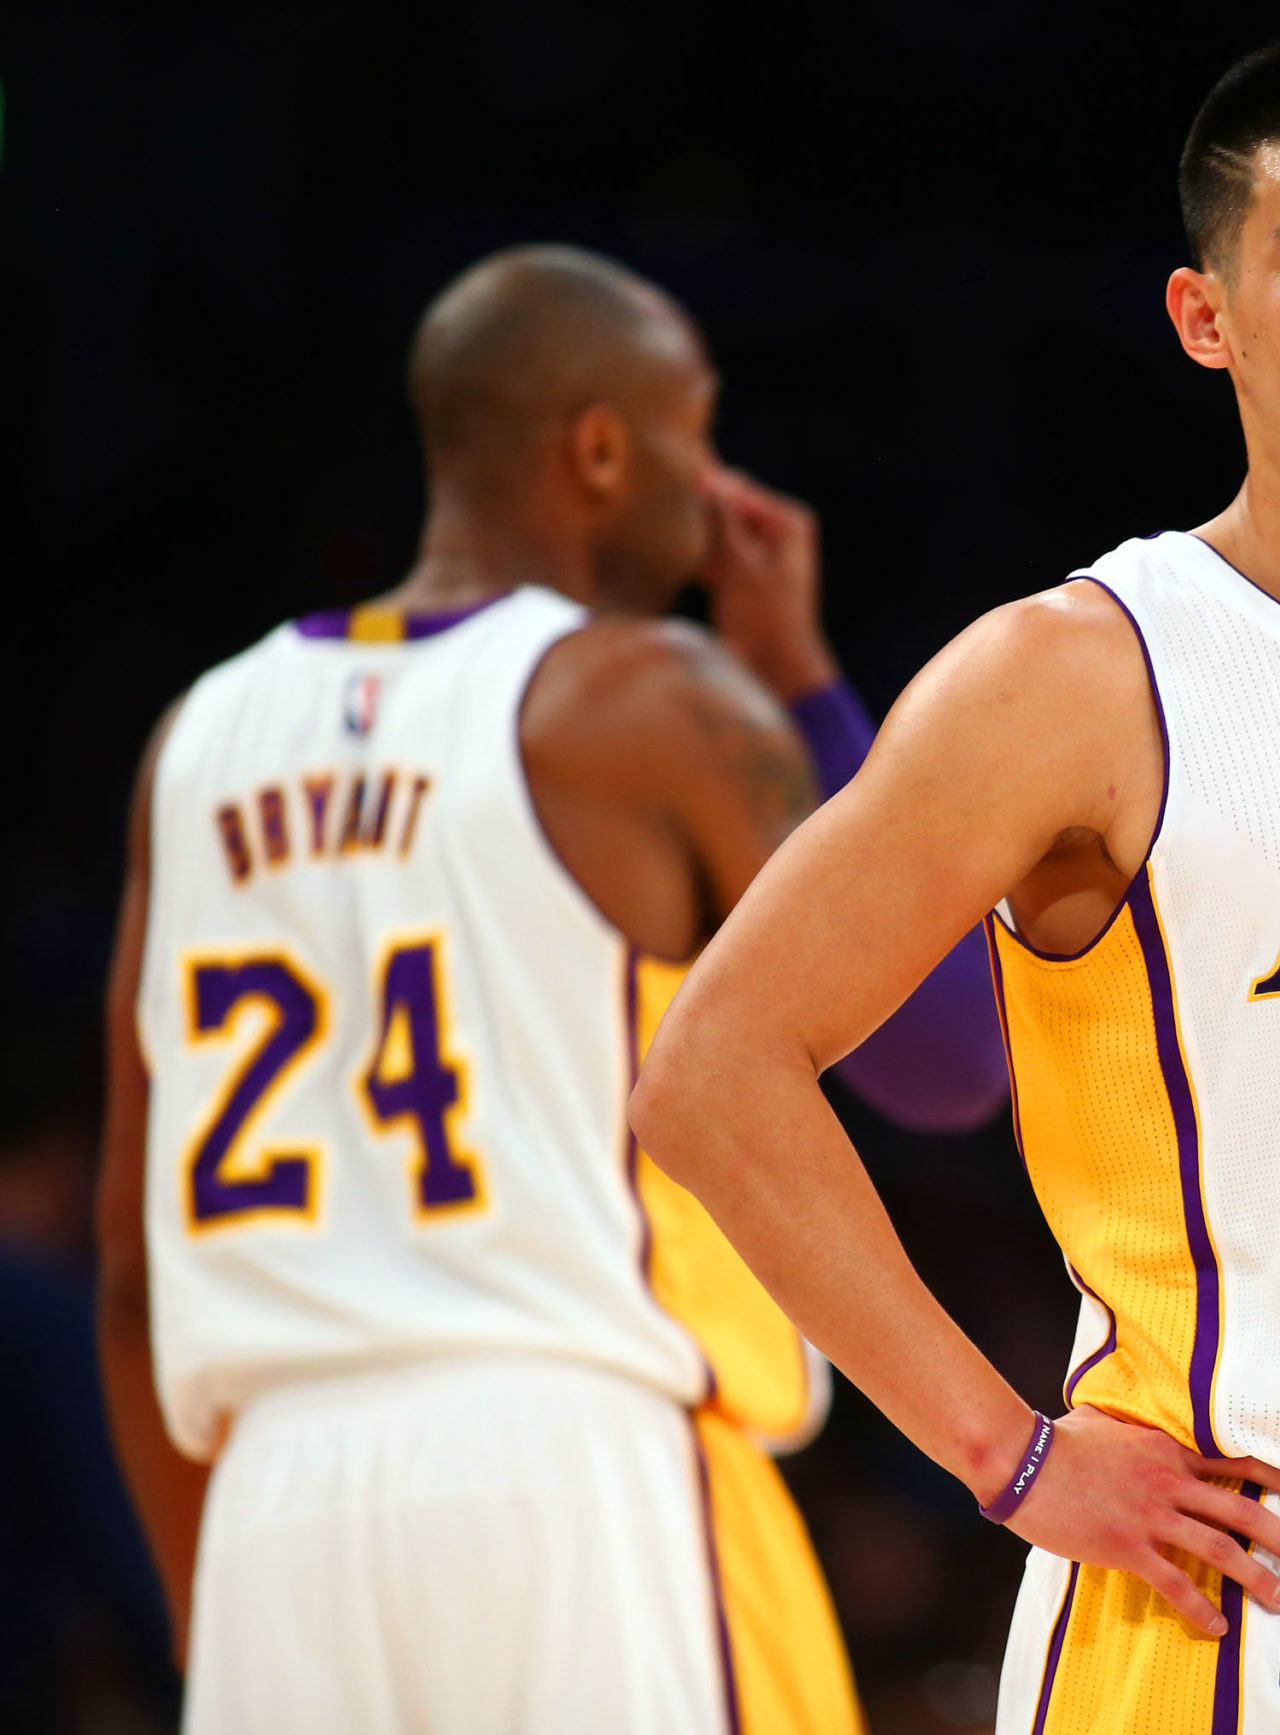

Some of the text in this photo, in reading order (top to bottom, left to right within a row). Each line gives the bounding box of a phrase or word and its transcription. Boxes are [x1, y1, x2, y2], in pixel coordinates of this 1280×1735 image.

[214, 766, 431, 888] BRYANT
[181, 928, 487, 1236] 24
[1034, 1424, 1051, 1455] NAME
[1013, 1463, 1036, 1495] PLAY
